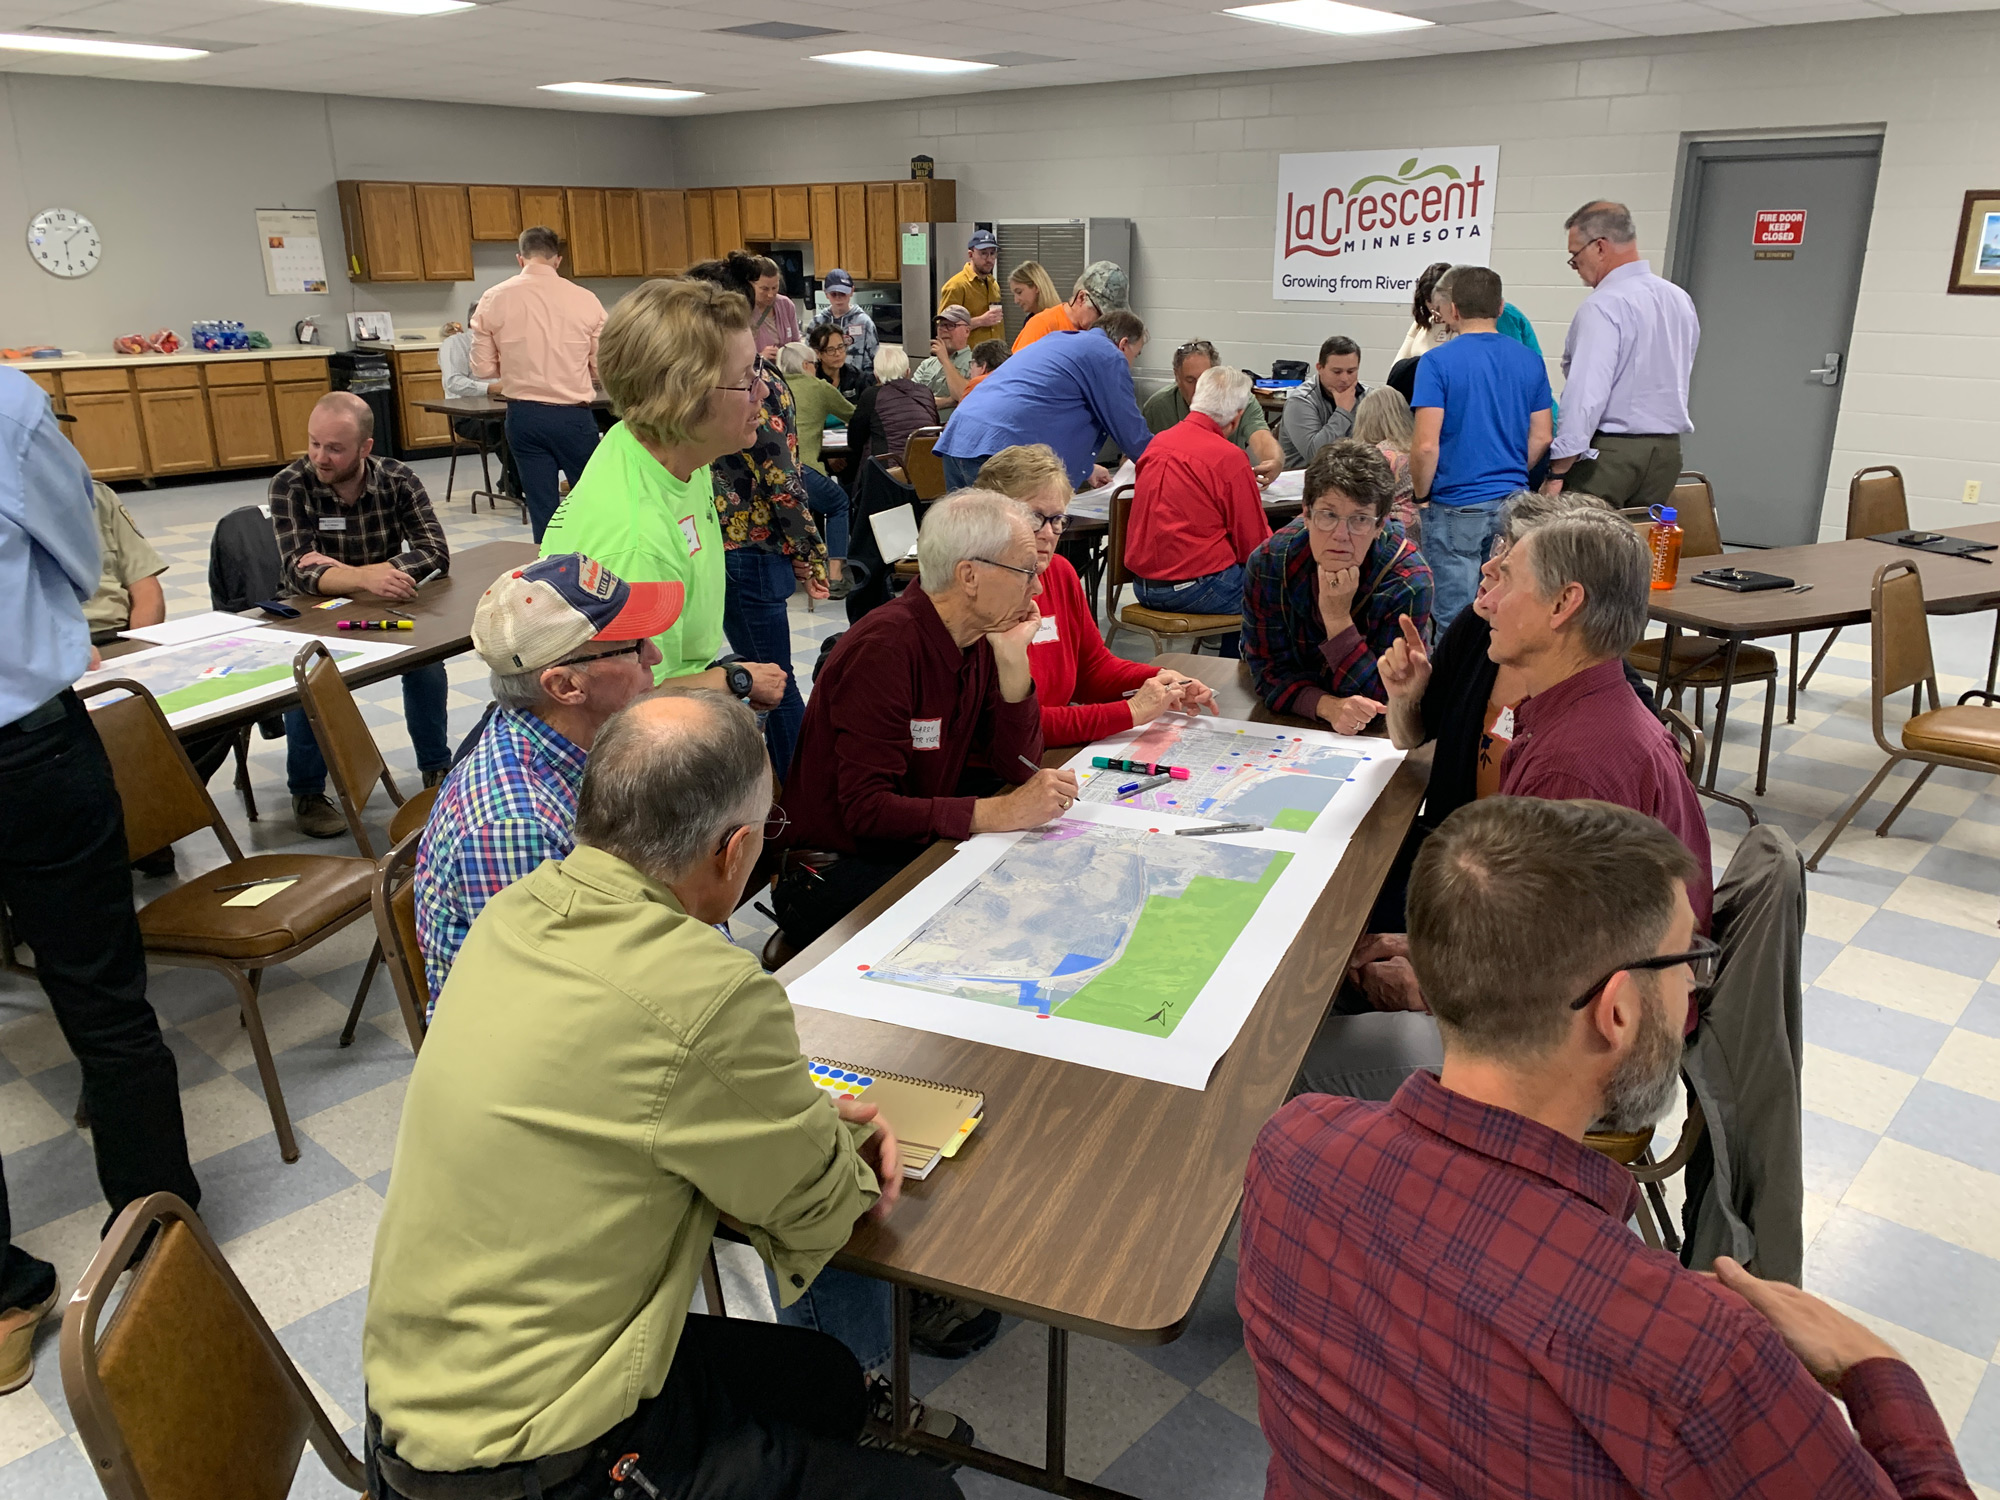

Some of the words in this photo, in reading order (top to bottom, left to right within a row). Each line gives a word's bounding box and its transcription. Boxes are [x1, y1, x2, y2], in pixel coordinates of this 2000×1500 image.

[1759, 213, 1778, 222] FIRE
[1779, 213, 1803, 222] DOOR
[1768, 223, 1791, 232] KEEP
[1344, 225, 1481, 253] MINNESOTA
[1762, 232, 1795, 241] CLOSED
[35, 238, 41, 246] 9
[1282, 273, 1338, 293] Growing
[1340, 274, 1373, 289] from
[1375, 275, 1413, 290] River
